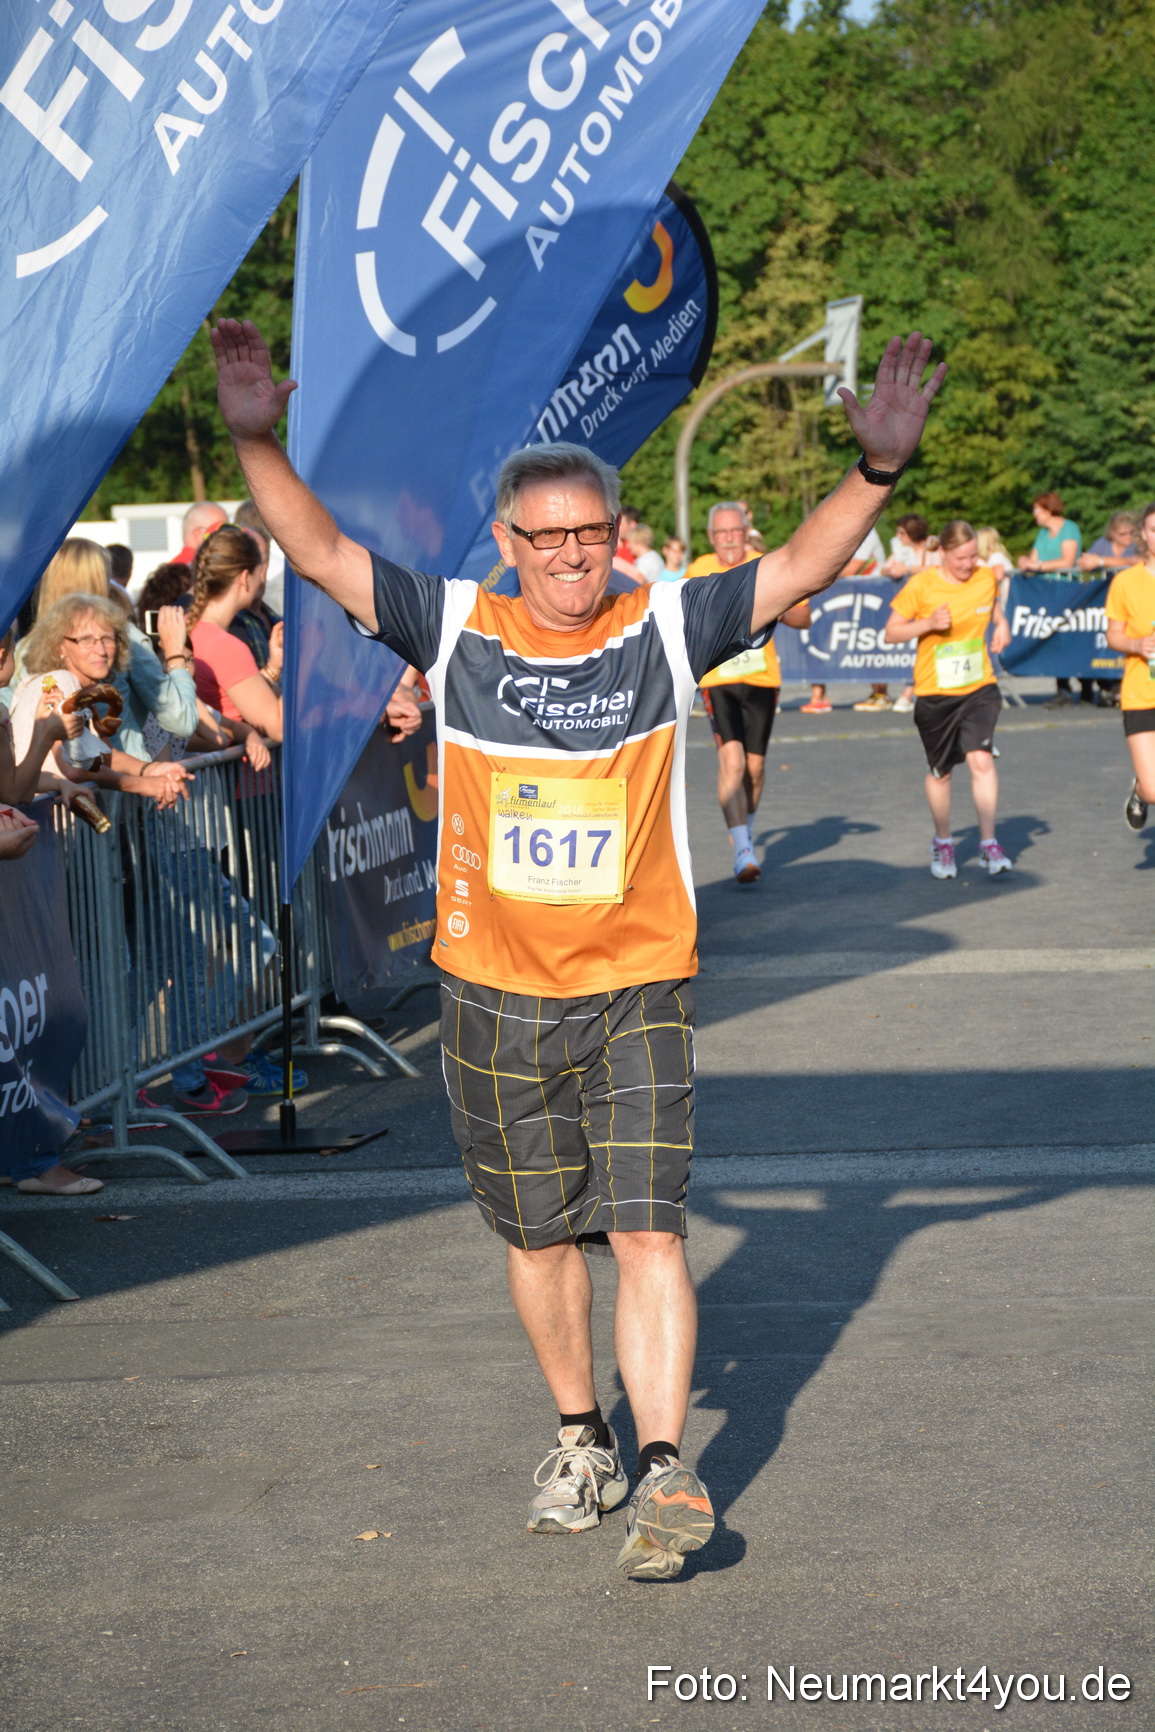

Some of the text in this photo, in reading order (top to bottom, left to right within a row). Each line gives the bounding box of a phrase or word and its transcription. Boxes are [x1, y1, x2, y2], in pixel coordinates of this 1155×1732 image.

[580, 385, 623, 439] Druck
[650, 299, 702, 368] Medien
[1011, 605, 1109, 639] Frischm
[951, 658, 972, 676] 74
[510, 796, 557, 809] firmenlauf
[504, 825, 612, 869] 1617
[422, 859, 438, 890] M
[453, 863, 468, 873] Audi
[527, 875, 582, 887] Franz Fischer
[450, 895, 473, 907] SEAT
[451, 917, 465, 932] FIAT
